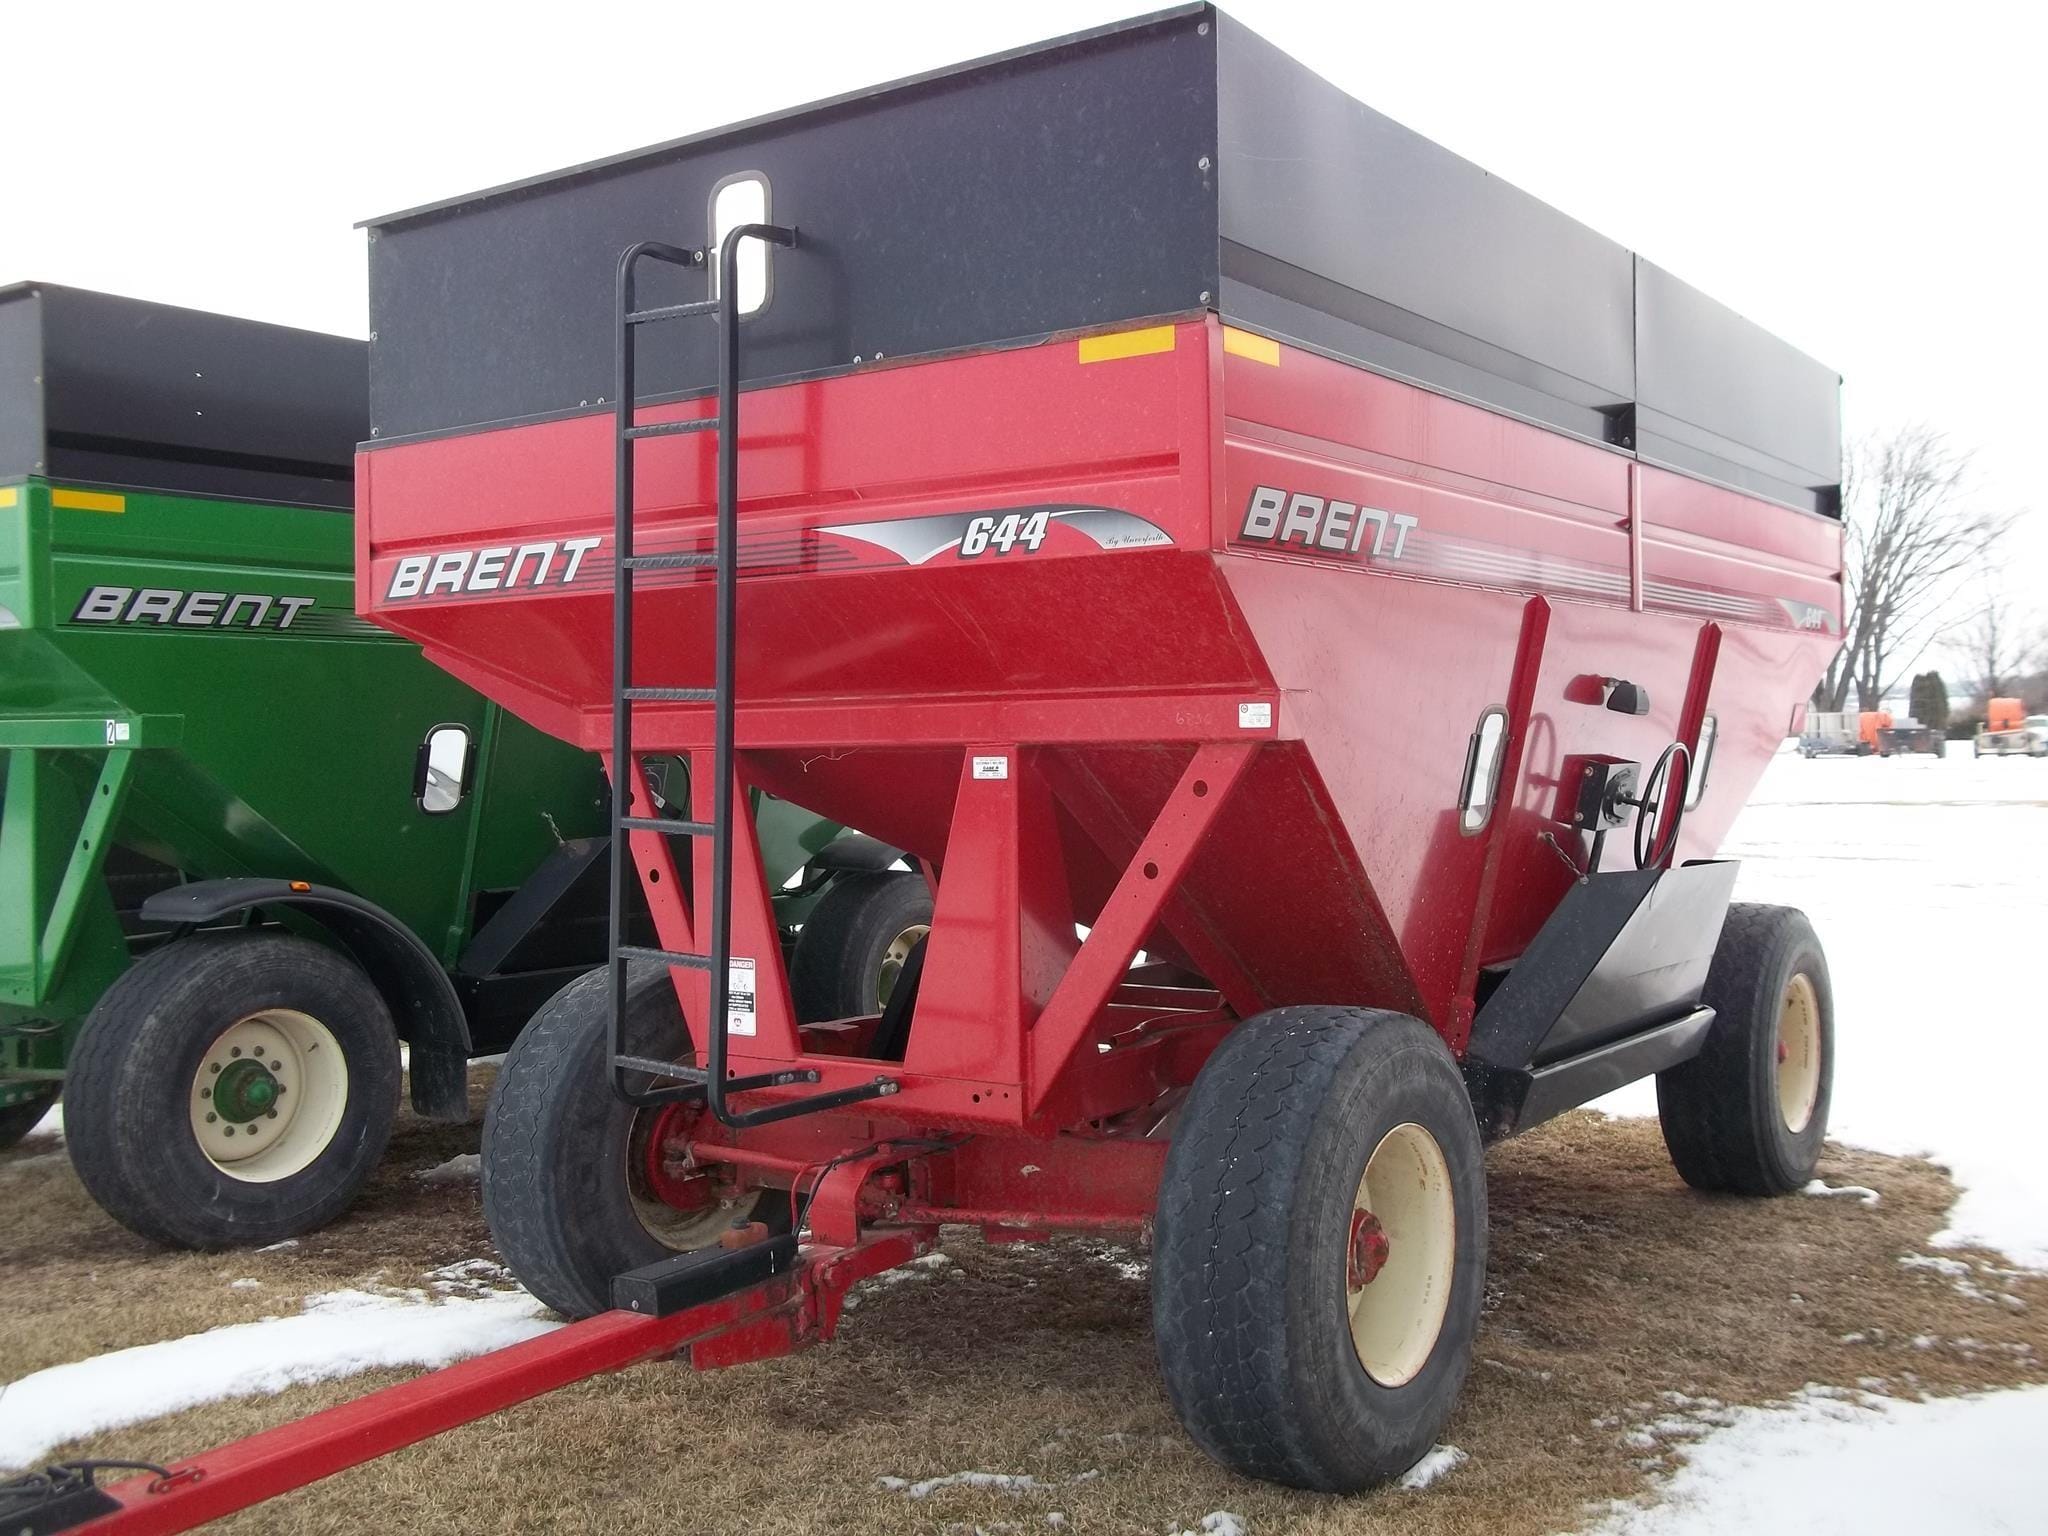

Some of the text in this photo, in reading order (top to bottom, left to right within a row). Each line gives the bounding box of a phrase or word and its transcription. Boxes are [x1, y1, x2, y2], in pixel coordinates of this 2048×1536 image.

[960, 510, 1050, 557] 644
[1105, 536, 1119, 546] By
[1242, 486, 1419, 559] BRENT
[387, 537, 602, 598] BRENT
[73, 586, 316, 629] BRENT
